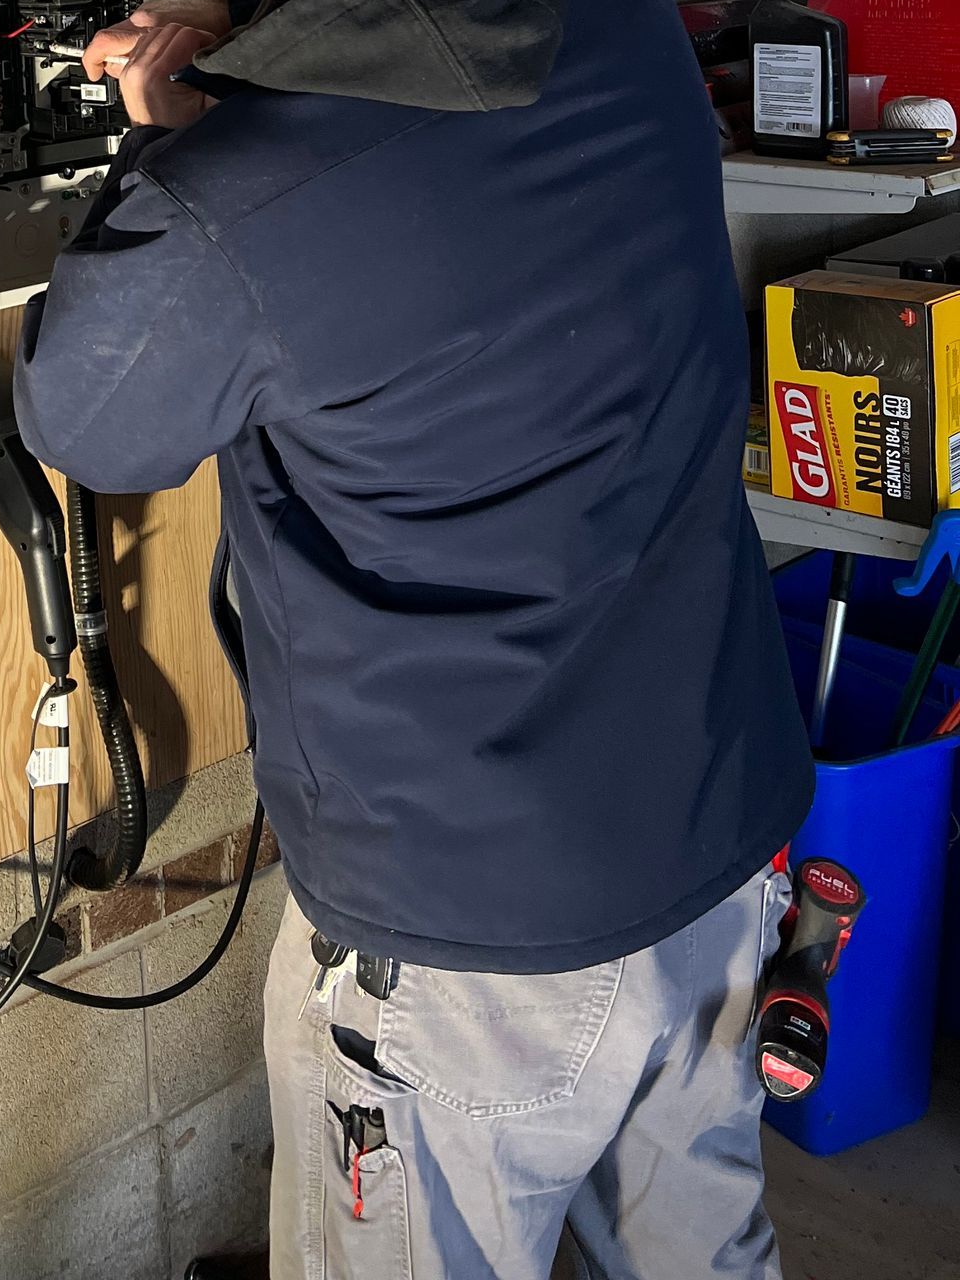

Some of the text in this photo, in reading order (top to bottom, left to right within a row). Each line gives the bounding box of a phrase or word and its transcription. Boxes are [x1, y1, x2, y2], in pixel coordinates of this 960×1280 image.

[885, 397, 900, 416] 40
[900, 399, 910, 417] SACS
[784, 388, 829, 497] GLAD
[853, 390, 882, 494] NOIRS
[885, 426, 901, 448] 184
[838, 457, 850, 505] GARANTIS
[884, 449, 902, 498] GÉANTS
